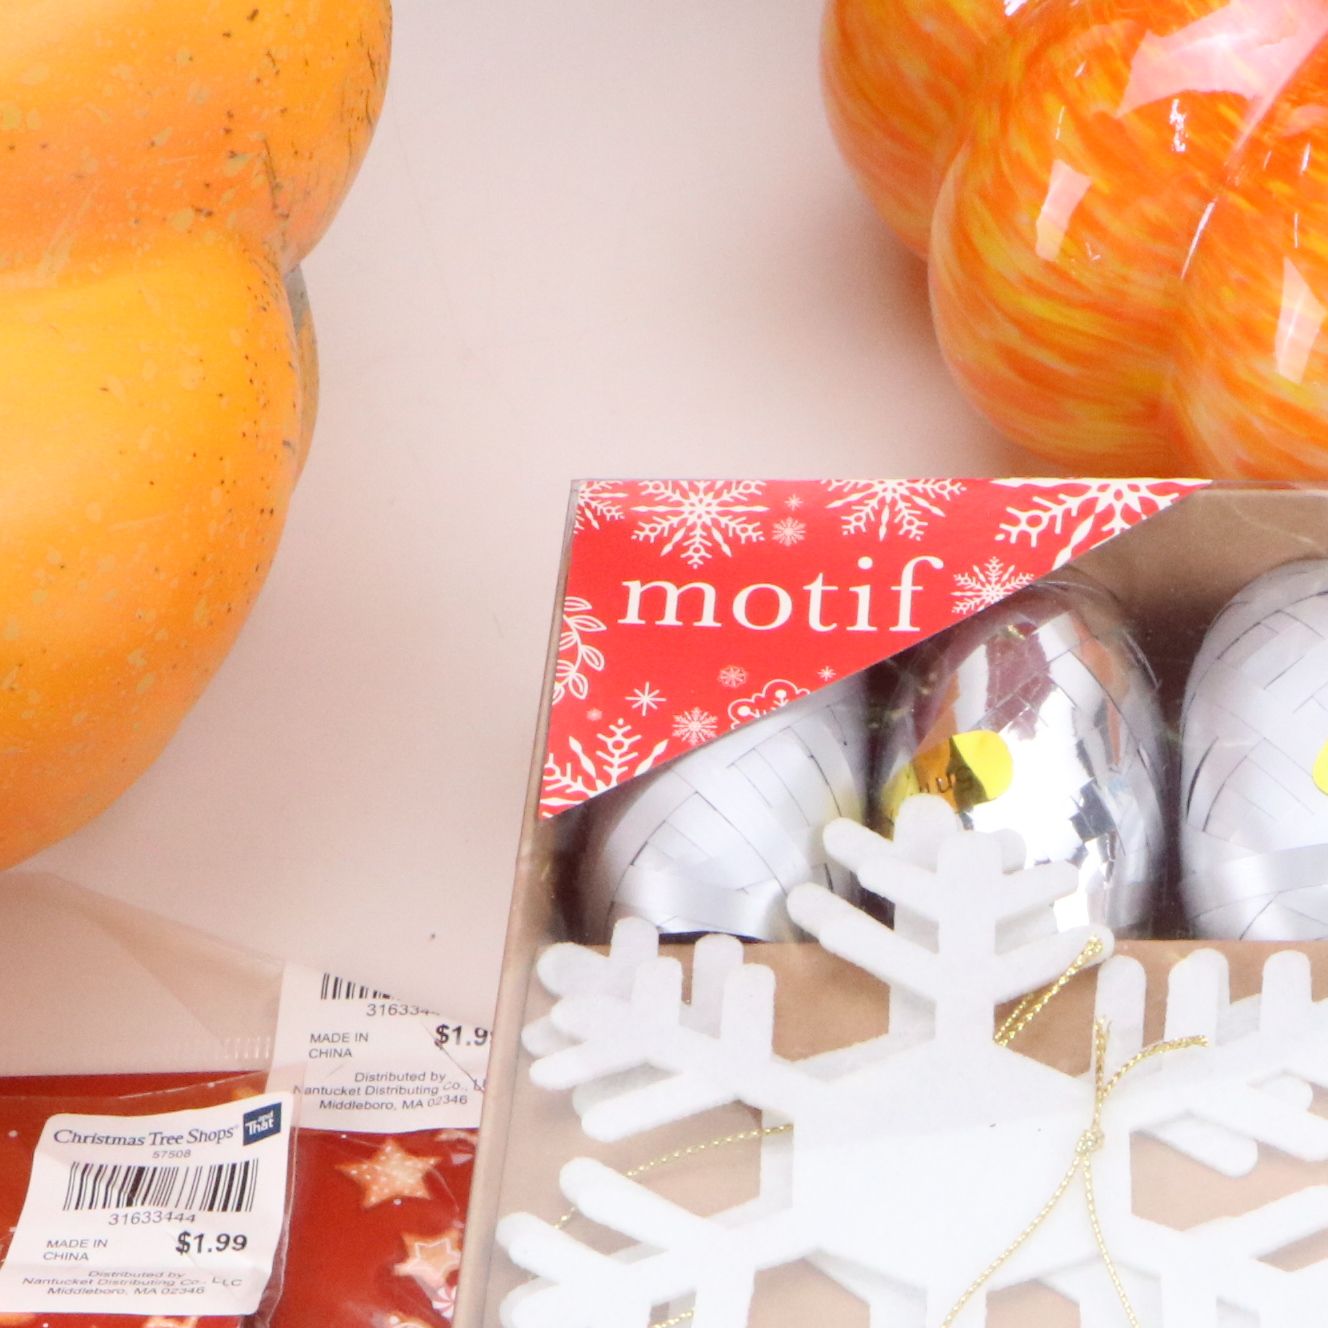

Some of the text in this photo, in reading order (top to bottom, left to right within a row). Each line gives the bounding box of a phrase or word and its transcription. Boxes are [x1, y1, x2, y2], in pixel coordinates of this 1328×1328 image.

[616, 556, 944, 632] motif
[310, 1032, 369, 1044] MADE IN
[435, 1024, 493, 1047] $1.9
[308, 1048, 353, 1059] CHINA
[354, 1071, 446, 1083] Distributed by
[293, 1084, 361, 1096] Nantucket
[365, 1084, 439, 1096] Distributing
[402, 1100, 425, 1110] MA
[427, 1095, 468, 1108] 02346
[53, 1126, 234, 1146] Christmas Tree Shops
[151, 1149, 192, 1160] 57508
[108, 1210, 196, 1226] 31633444
[46, 1238, 108, 1249] MADE IN
[175, 1230, 248, 1255] $1.99
[43, 1251, 89, 1261] CHINA
[88, 1270, 185, 1279] Distributed by
[22, 1277, 94, 1286] Nantucket
[97, 1278, 176, 1287] Distributing
[212, 1276, 243, 1287] LLC
[134, 1286, 157, 1295] MA
[160, 1286, 206, 1295] 02346
